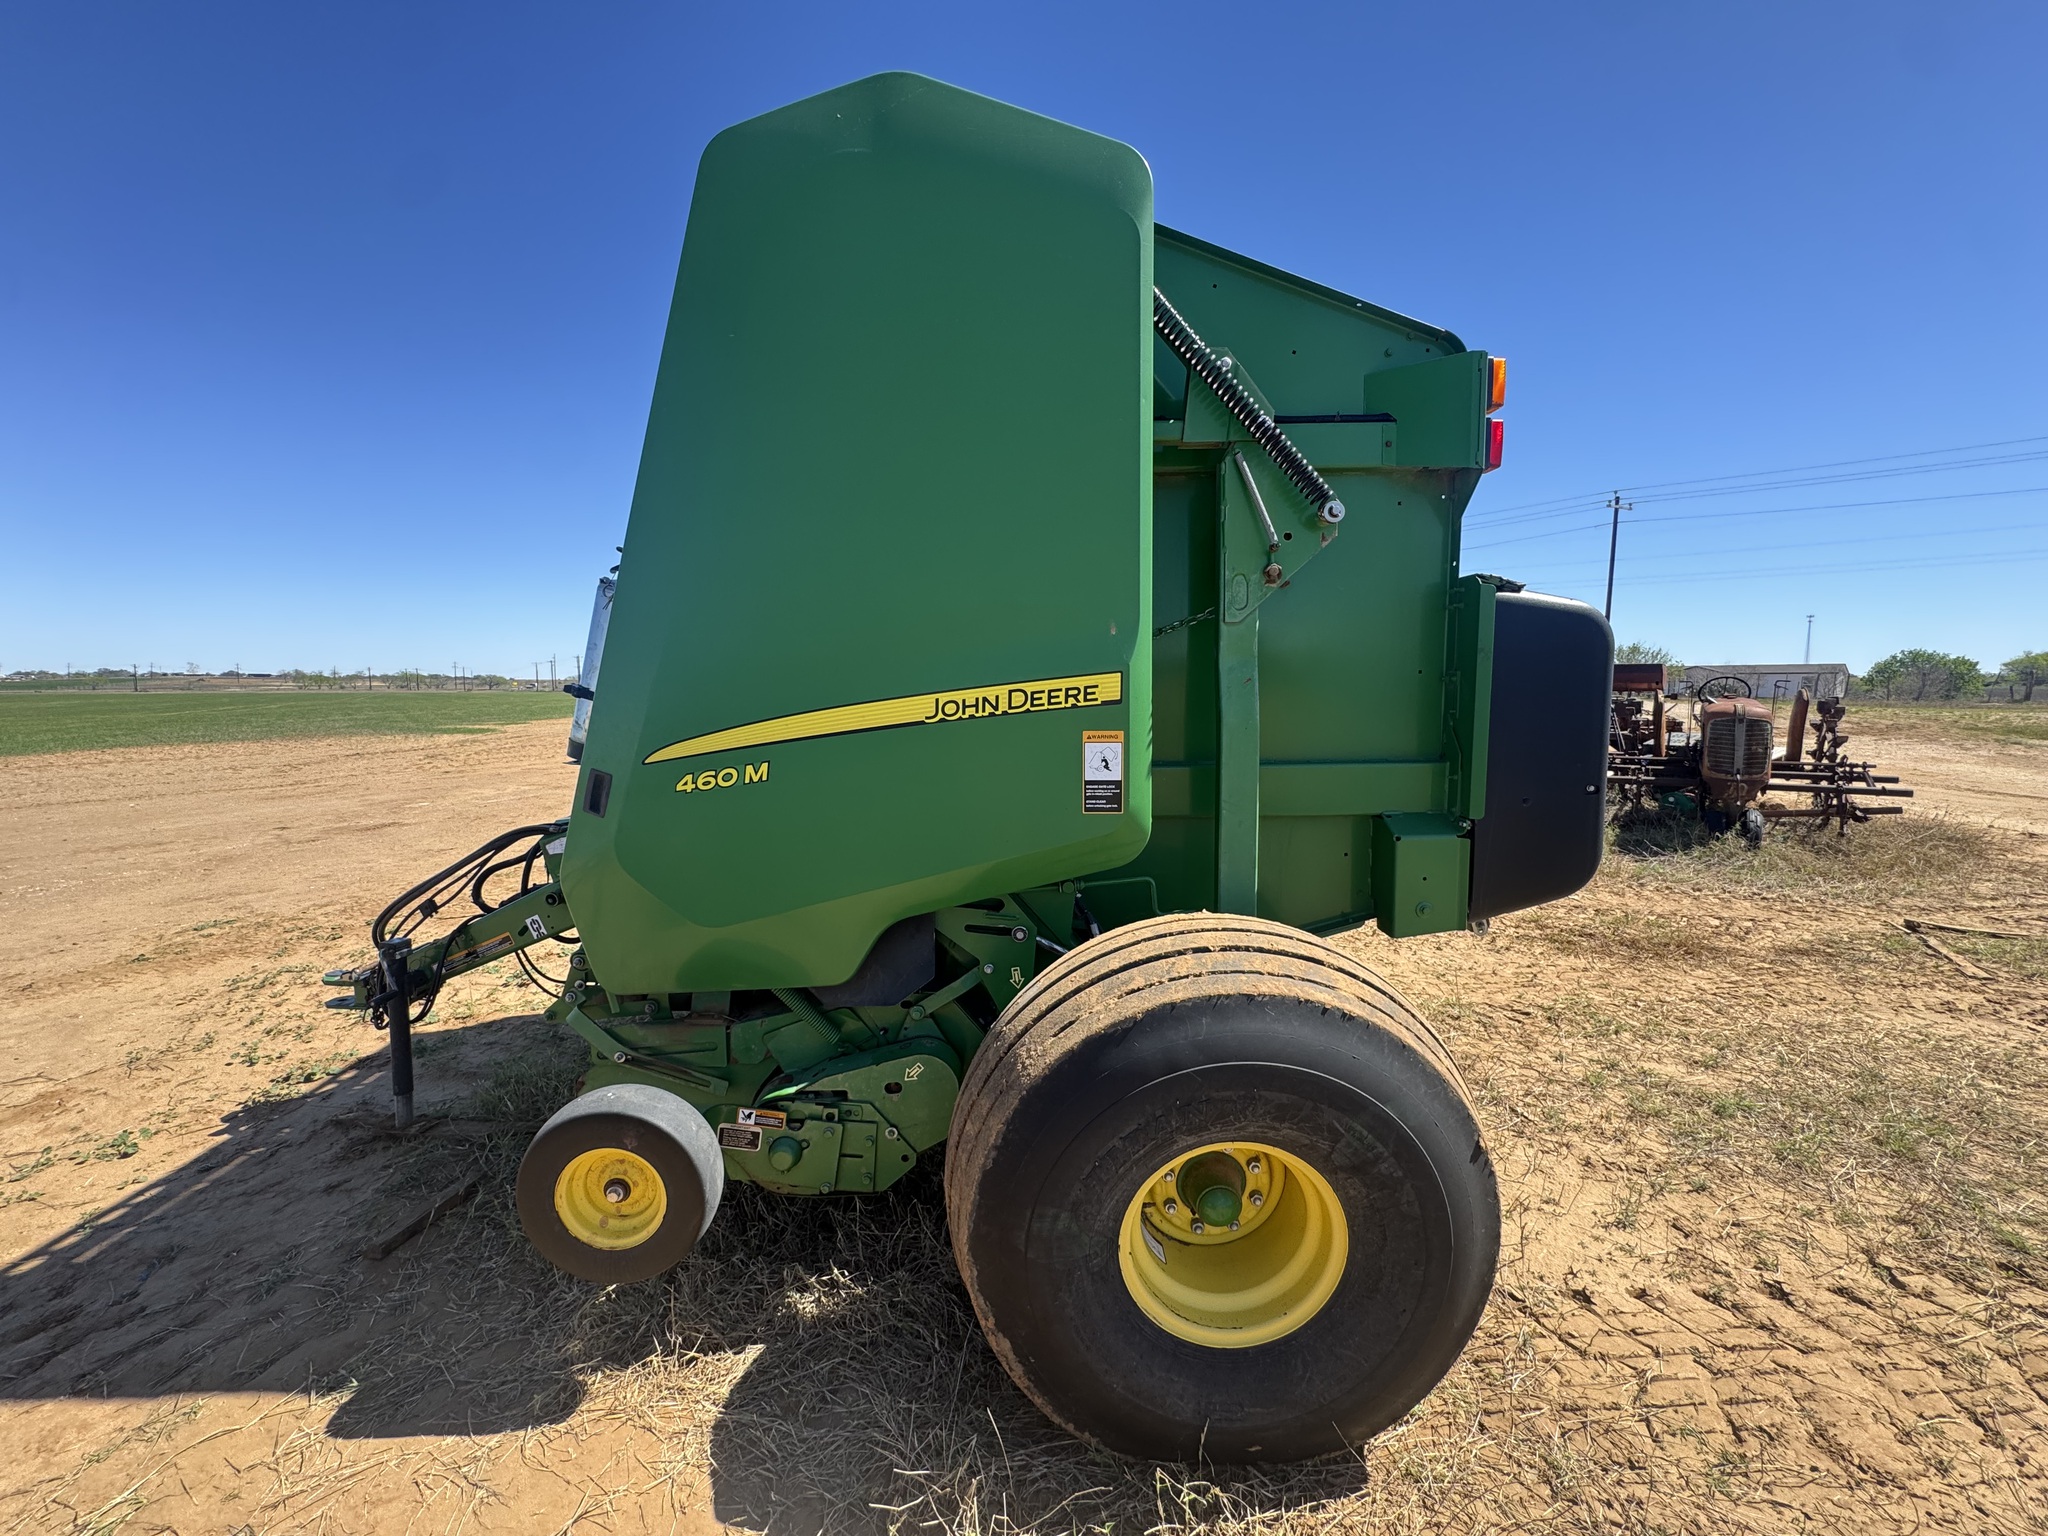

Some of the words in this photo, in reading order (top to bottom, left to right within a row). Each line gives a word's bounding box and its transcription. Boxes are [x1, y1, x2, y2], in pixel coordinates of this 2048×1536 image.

[925, 695, 1000, 721] JOHN
[1008, 684, 1099, 711] DEERE
[675, 766, 739, 794] 460
[743, 760, 770, 785] M
